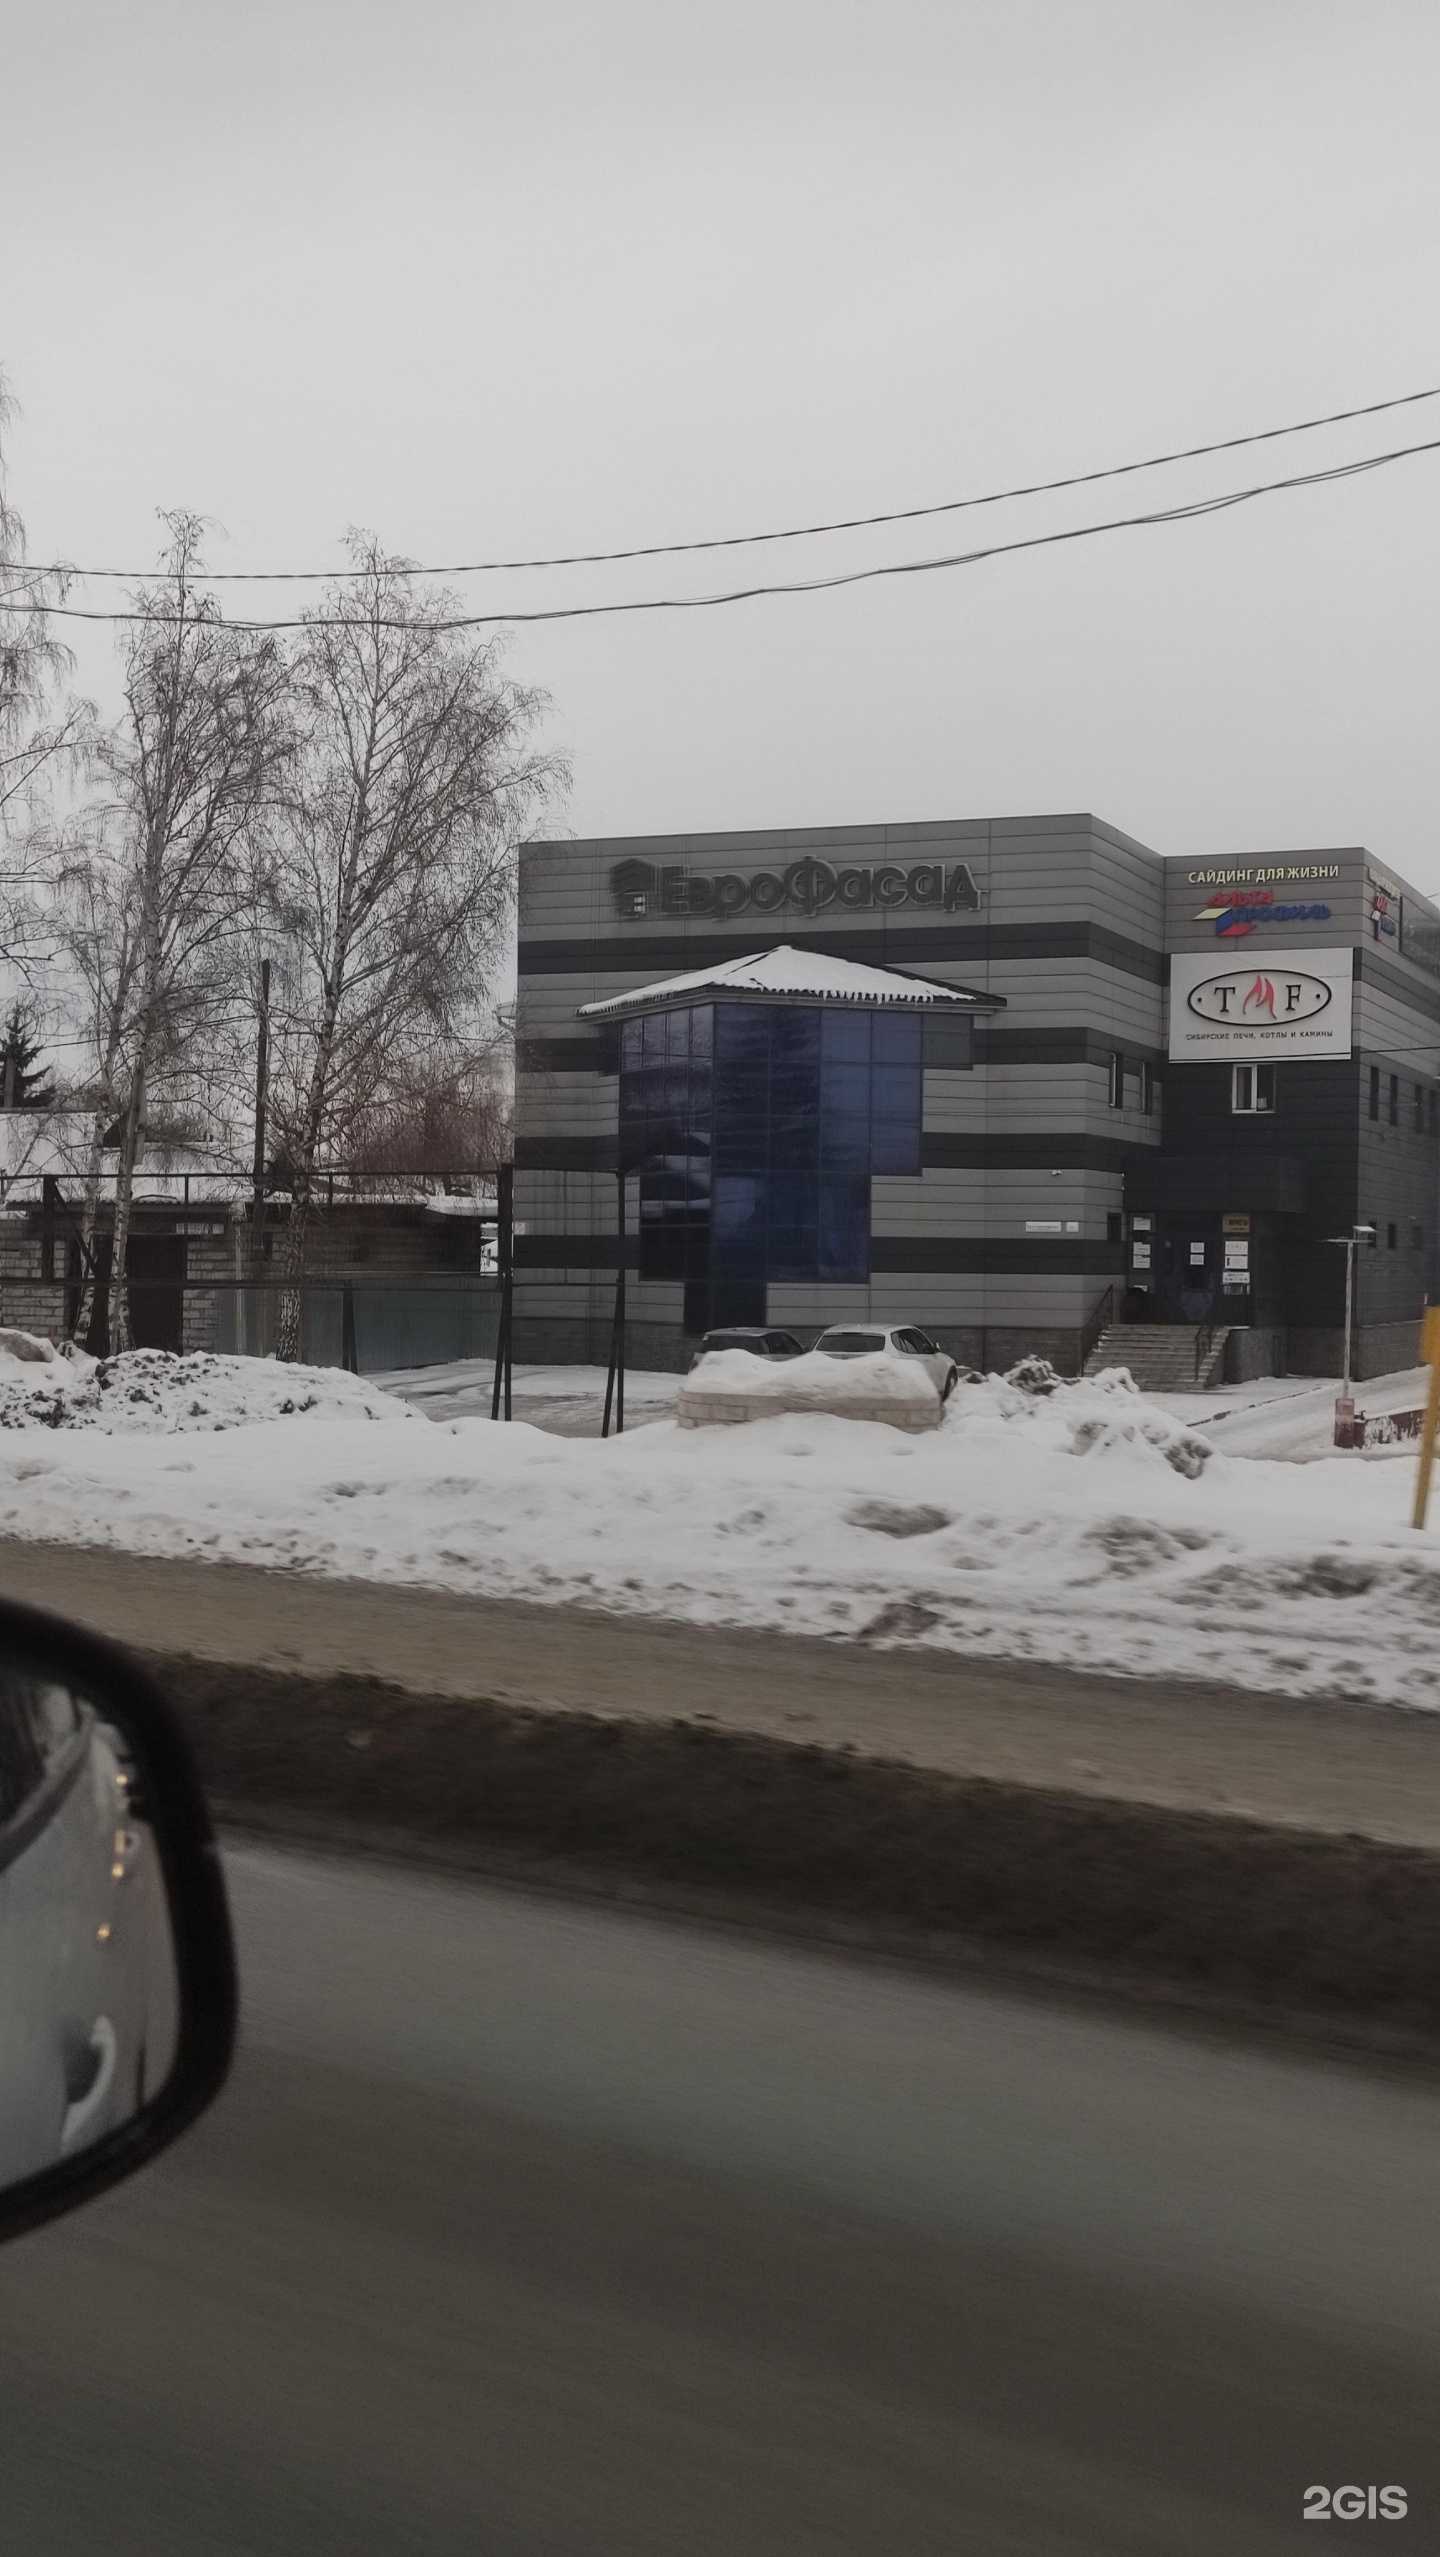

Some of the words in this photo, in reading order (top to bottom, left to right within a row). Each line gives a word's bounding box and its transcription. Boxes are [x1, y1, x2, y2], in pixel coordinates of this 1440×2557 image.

[1188, 869, 1252, 884] САЙДИНГ
[1256, 868, 1284, 883] ДЛЯ
[1287, 865, 1339, 880] ЖИЗНИ
[1260, 1031, 1288, 1039] КОТЛЫ
[1299, 1030, 1333, 1038] КАМИНЫ
